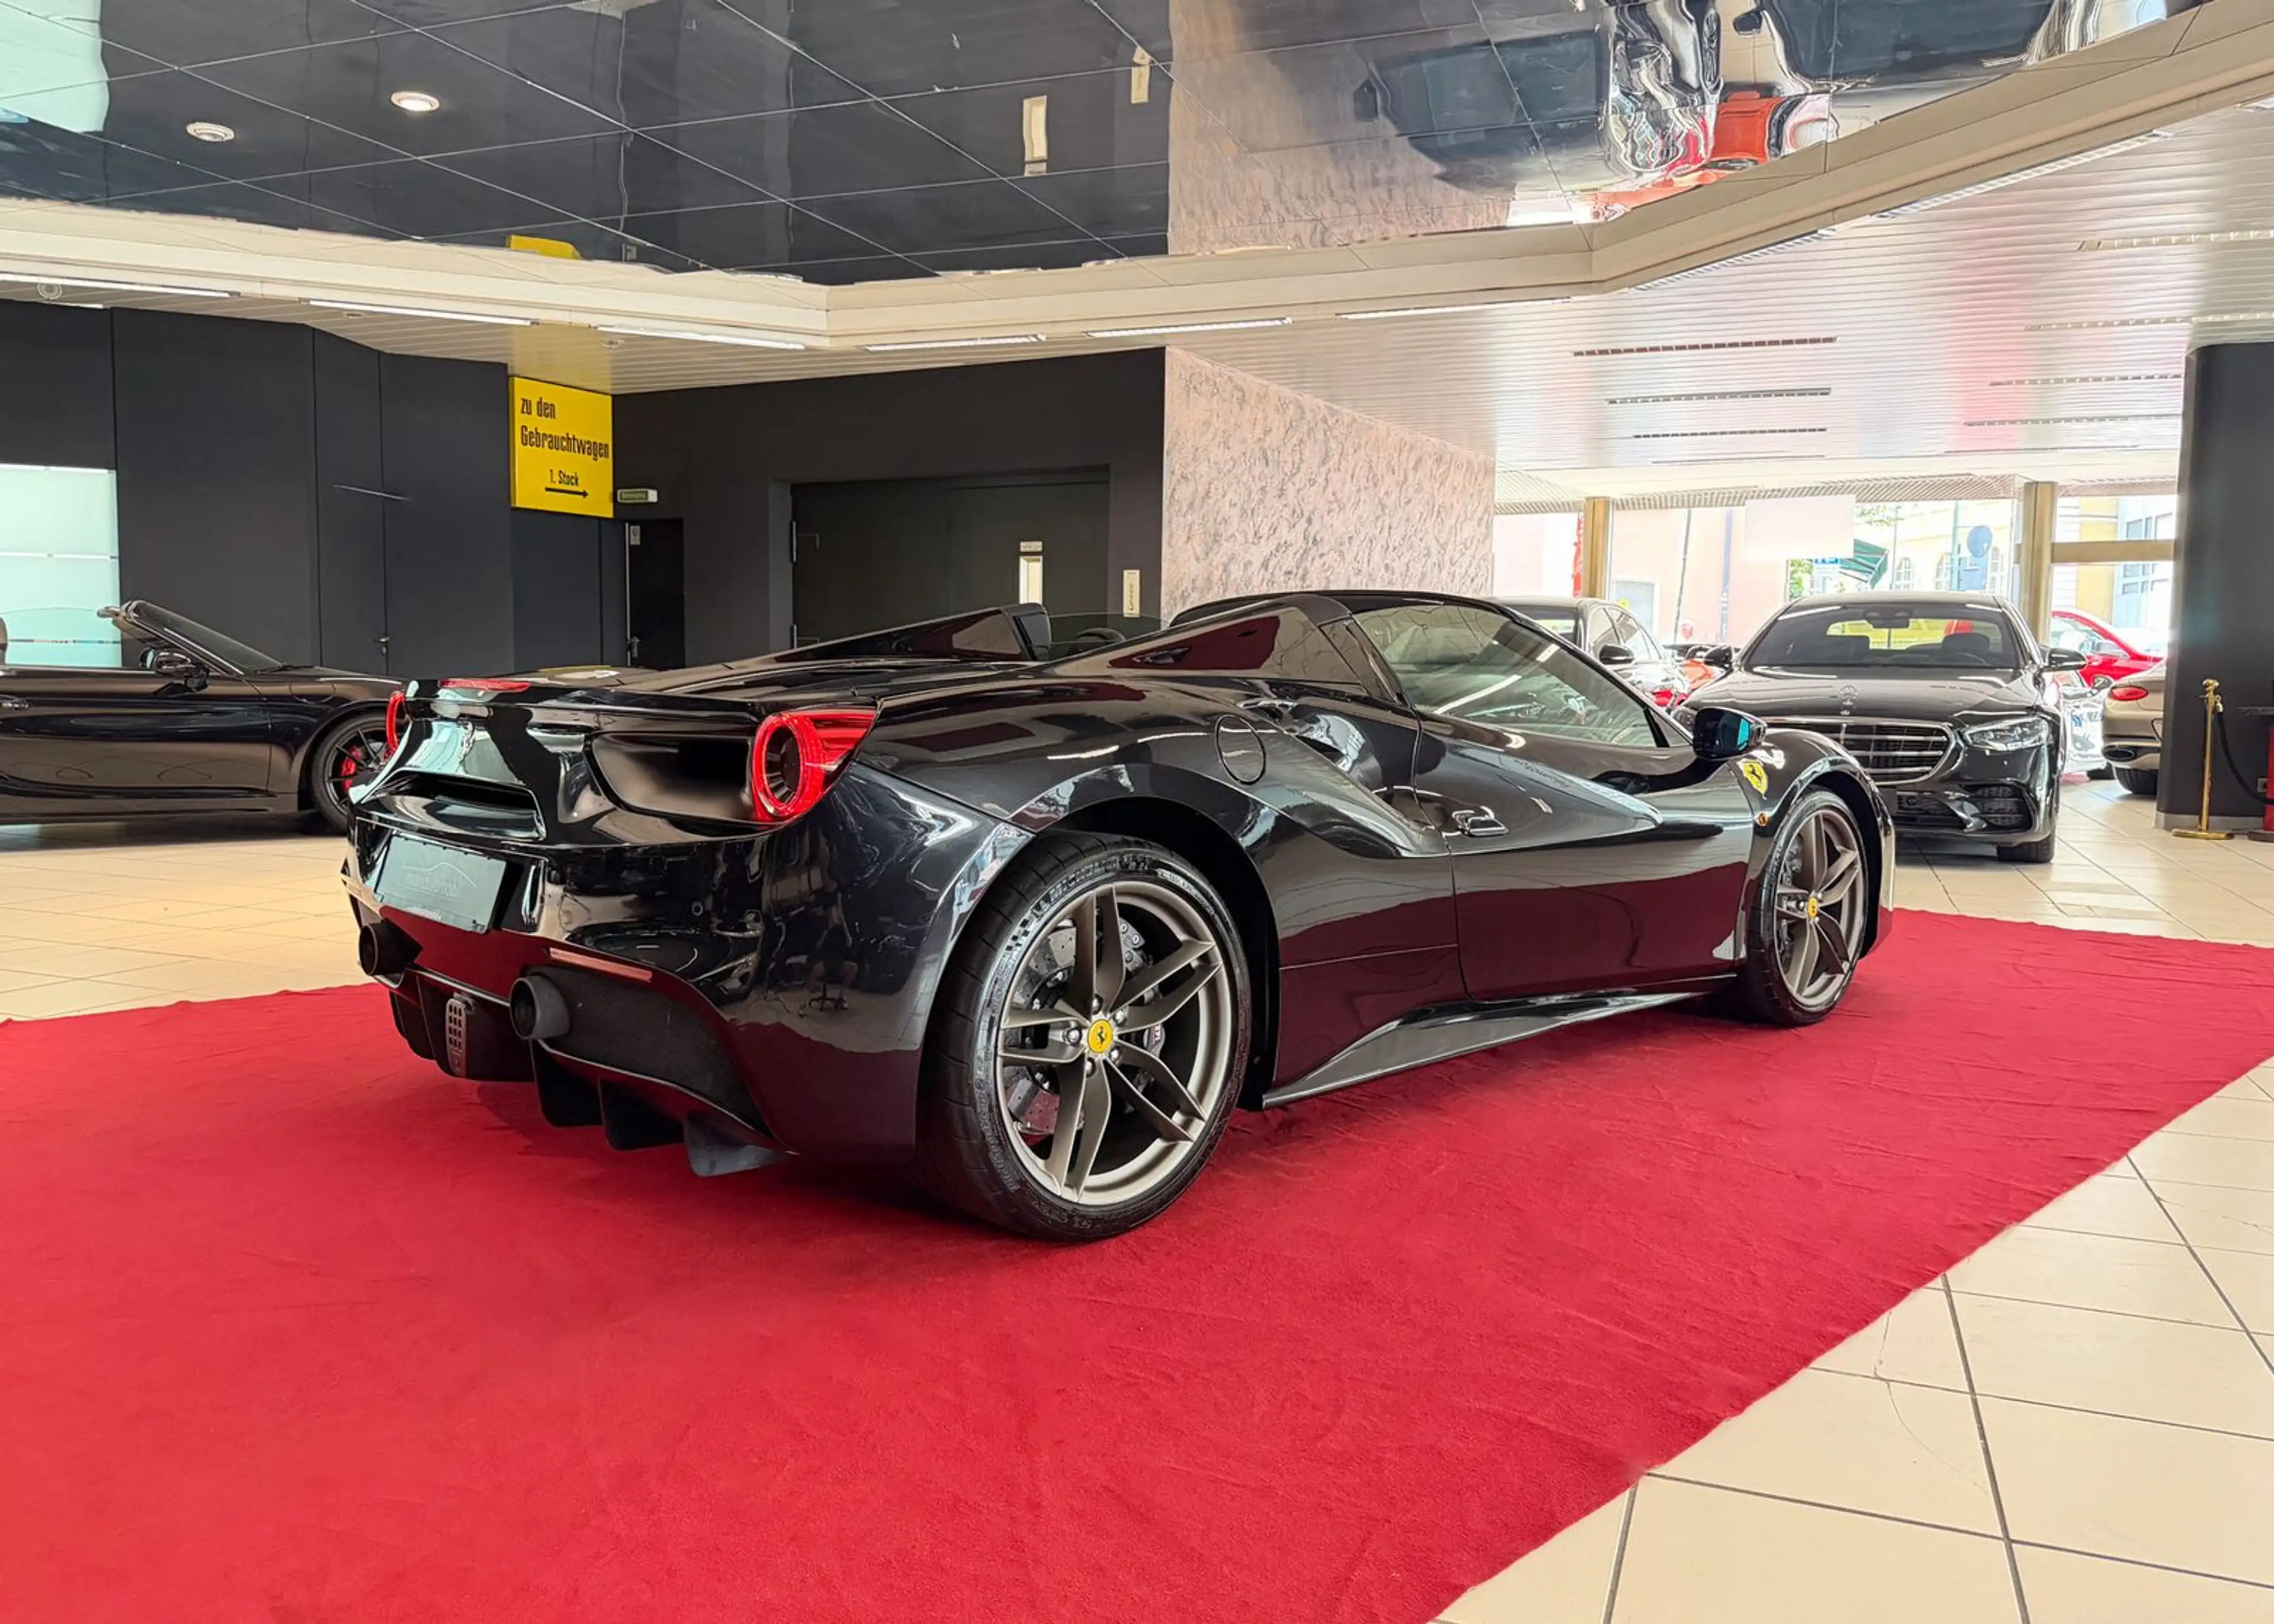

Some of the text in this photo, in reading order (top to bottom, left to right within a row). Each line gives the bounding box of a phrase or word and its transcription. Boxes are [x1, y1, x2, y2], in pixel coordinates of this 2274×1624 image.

[521, 397, 555, 419] zu den
[521, 425, 609, 461] Gebrauchtwagen
[550, 468, 579, 486] 1. Stock
